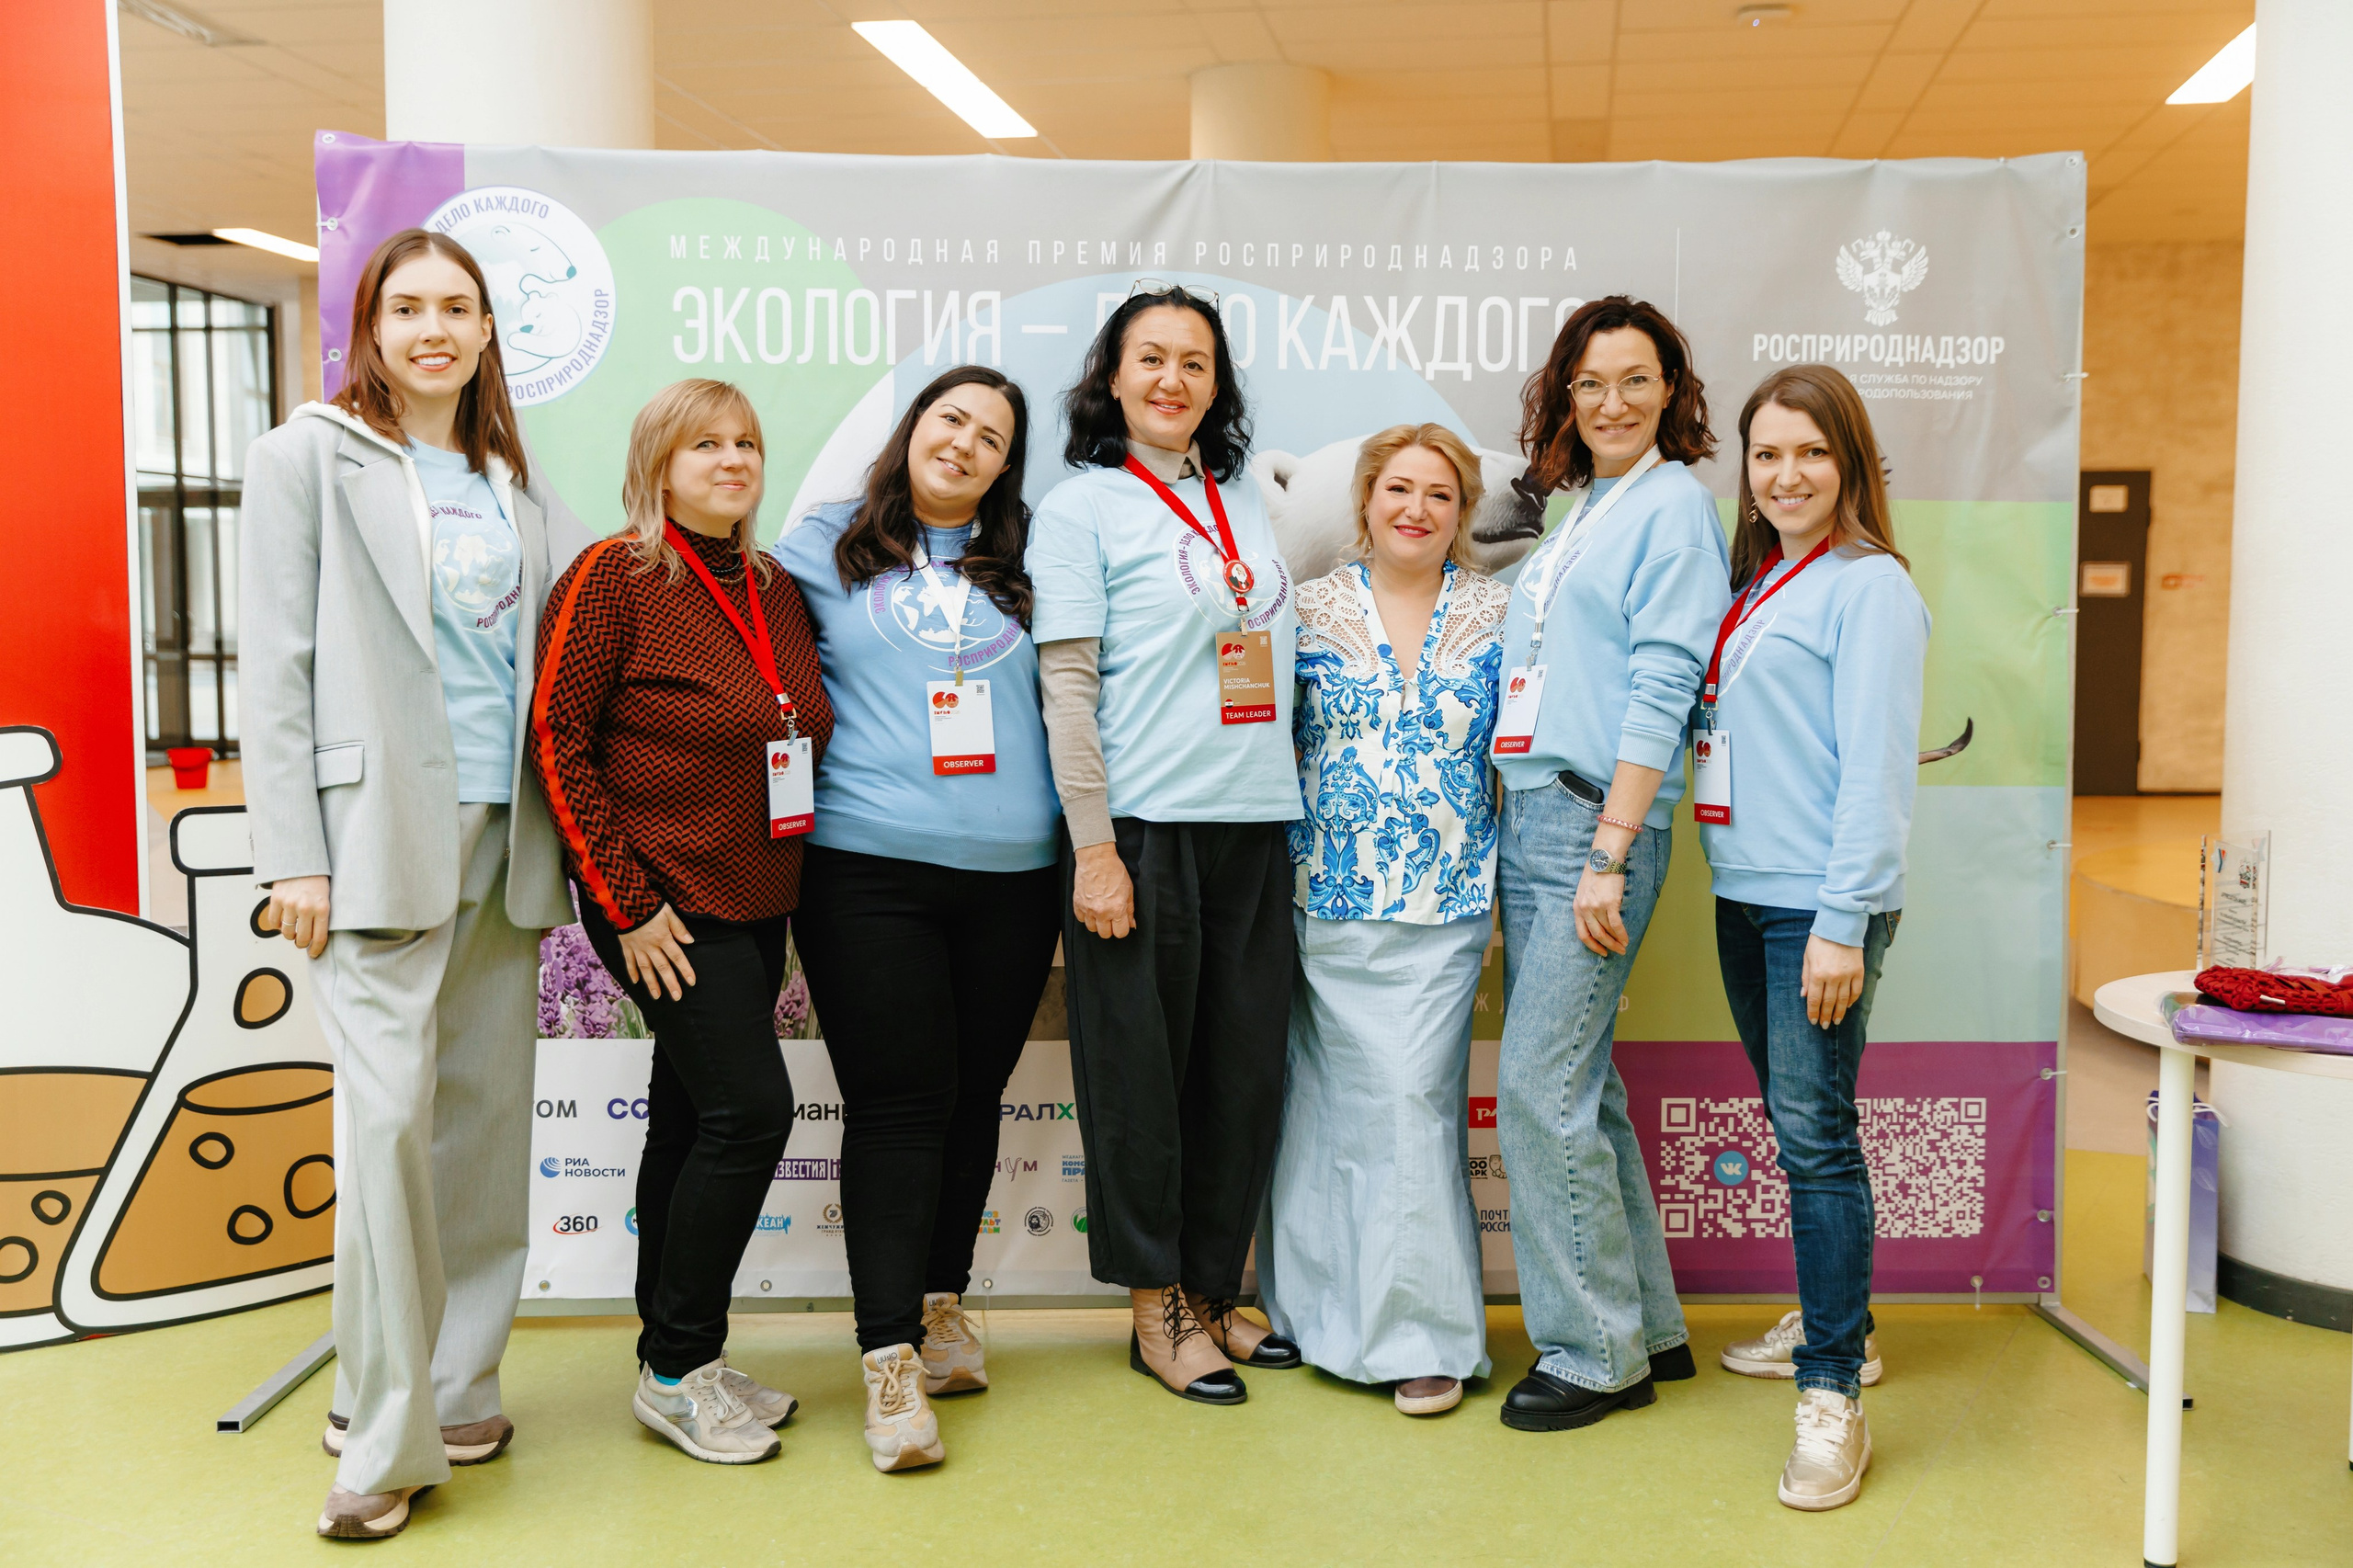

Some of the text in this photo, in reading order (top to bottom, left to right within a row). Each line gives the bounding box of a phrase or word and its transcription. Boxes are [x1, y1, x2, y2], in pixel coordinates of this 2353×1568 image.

[435, 196, 550, 234] ДЕЛО КАЖДОГО
[669, 235, 1578, 272] МЕЖДУНАРОДНАЯ ПРЕМИЯ РОСПРИРОДНАДЗОРА
[672, 286, 1002, 367] ЭКОЛОГИЯ
[507, 289, 610, 401] РОСПРИРОДНАДЗОР
[1752, 333, 2006, 369] РОСПРИРОДНАДЗОР
[1859, 374, 1909, 384] СЛУЖБА
[1912, 375, 1927, 384] ПО
[1929, 375, 1984, 387] НАДЗОРУ
[1857, 388, 1973, 400] РОДОПОЛЬЗОВАНИЯ
[1247, 559, 1289, 629] ОСПРИРОДНАДЗОР
[1225, 710, 1271, 720] TEAM LEADER
[1500, 740, 1526, 749] OBSERVER
[943, 759, 984, 768] OBSERVER
[1699, 809, 1724, 819] OBSERVER
[778, 819, 807, 831] OBSERVER
[999, 1102, 1076, 1121] РАЛХ
[564, 1157, 590, 1166] РИА
[564, 1168, 626, 1177] НОВОСТИ
[1481, 1210, 1509, 1221] ПОЧТ
[559, 1215, 598, 1233] 360
[756, 1217, 784, 1228] КЕАН
[1480, 1221, 1510, 1233] РОССИ
